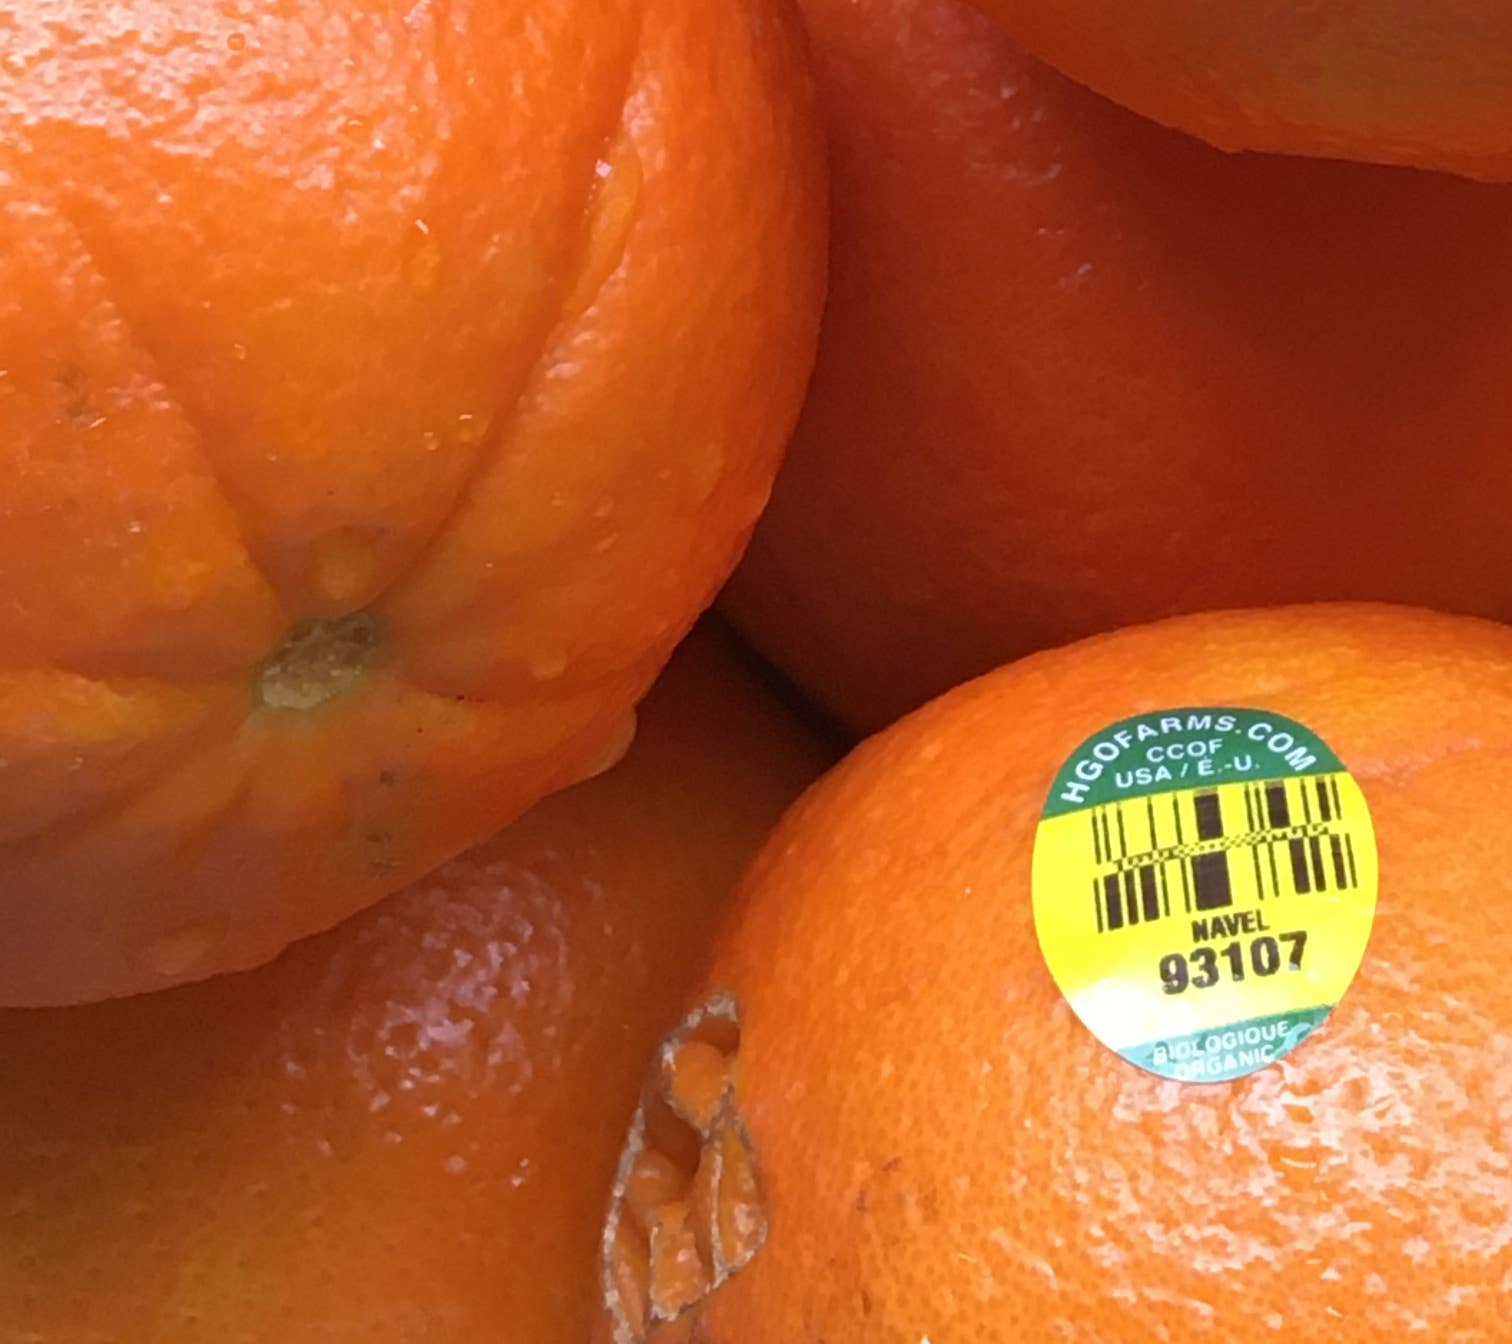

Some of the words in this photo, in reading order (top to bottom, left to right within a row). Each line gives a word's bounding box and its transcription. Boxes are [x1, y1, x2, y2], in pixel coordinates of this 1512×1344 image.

[1061, 714, 1318, 804] HGOFARMS.COM
[1146, 738, 1223, 763] CCOF
[1115, 765, 1173, 788] USA
[1191, 909, 1270, 944] NAVEL
[1159, 930, 1308, 995] 93107
[1153, 1020, 1290, 1065] BIOLOGIQUE
